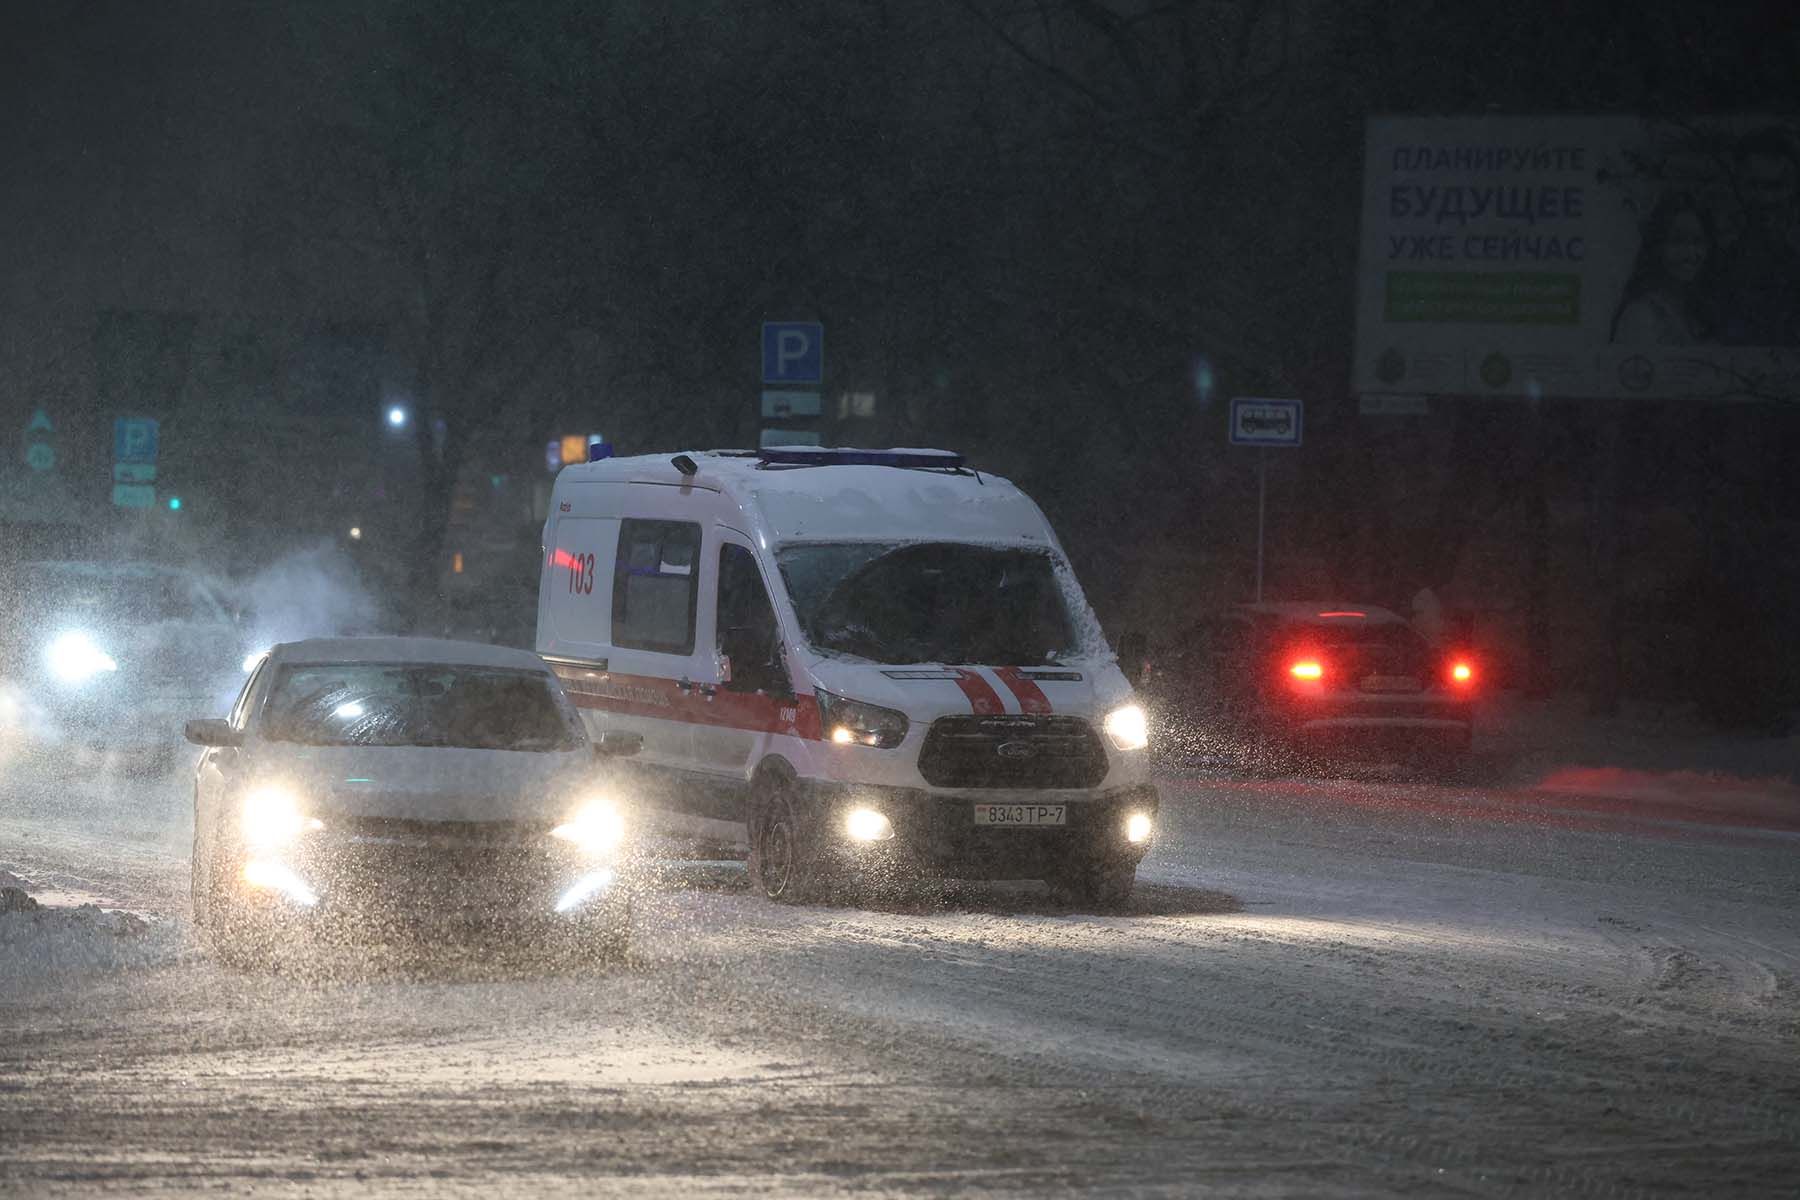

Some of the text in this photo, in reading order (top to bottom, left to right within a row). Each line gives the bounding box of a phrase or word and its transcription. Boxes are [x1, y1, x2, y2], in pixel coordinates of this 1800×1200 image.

[1392, 143, 1585, 172] ПЛАНИРУЙТЕ
[1391, 186, 1585, 227] БУДУЩЕЕ
[1388, 229, 1585, 262] УЖЕ СЕЙЧАС
[777, 329, 809, 376] P
[568, 552, 595, 595] 103
